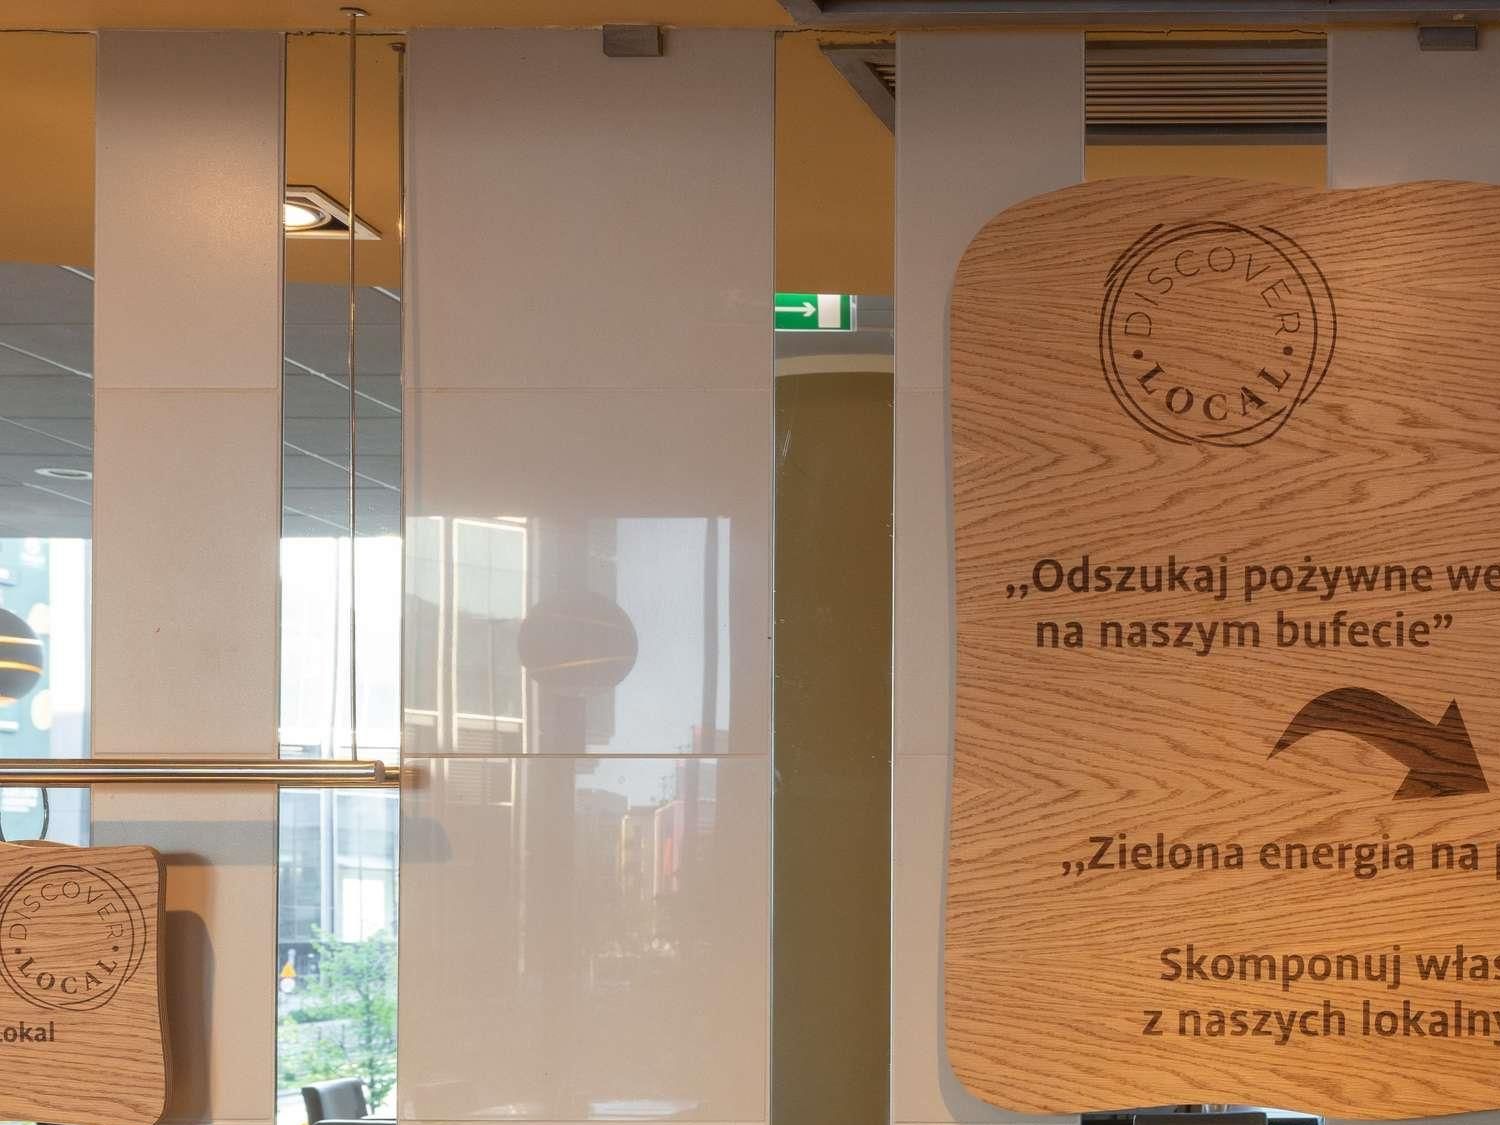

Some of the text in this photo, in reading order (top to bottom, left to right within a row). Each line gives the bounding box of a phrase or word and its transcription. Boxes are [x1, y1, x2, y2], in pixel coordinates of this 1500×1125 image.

[1125, 246, 1300, 336] DISCOVER
[1136, 362, 1291, 421] LOCAL
[1244, 555, 1433, 603] pożywne
[1036, 619, 1084, 648] na
[1100, 619, 1261, 657] naszym
[1259, 833, 1415, 880] energia
[1431, 842, 1479, 871] na
[9, 881, 124, 941] DISCOVER
[17, 957, 119, 994] LOCAL
[1160, 944, 1401, 992] Skomponuj
[1142, 1009, 1164, 1036] z
[1177, 999, 1346, 1046] naszych
